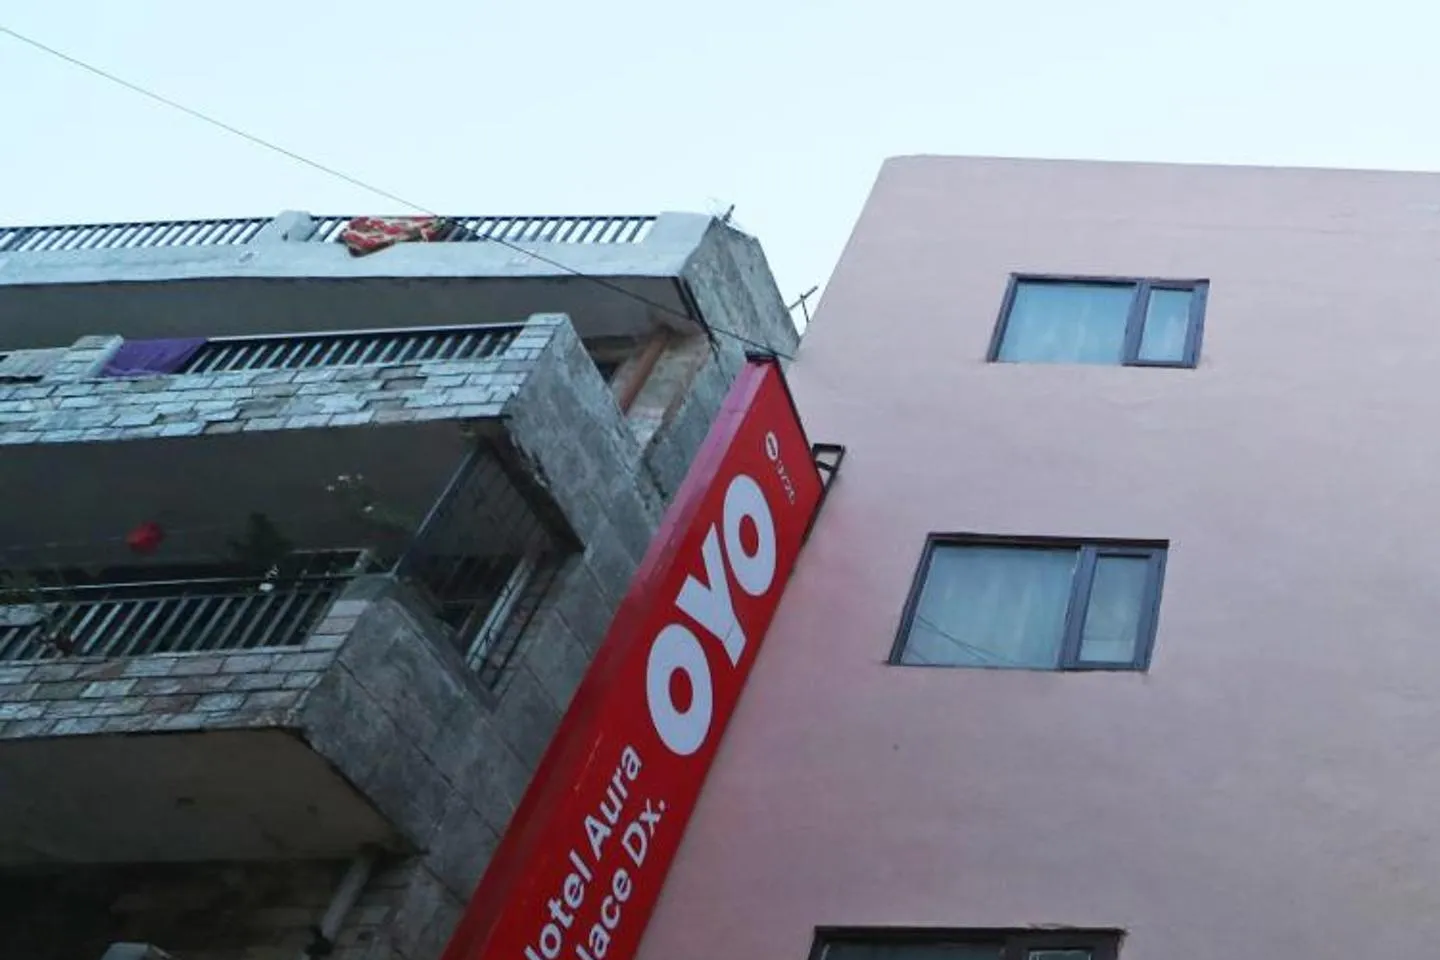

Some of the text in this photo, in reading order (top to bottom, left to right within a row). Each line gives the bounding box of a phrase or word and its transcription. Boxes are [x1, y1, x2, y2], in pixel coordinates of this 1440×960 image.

[646, 474, 778, 757] OYO
[581, 743, 643, 845] Aura
[621, 800, 667, 884] Dx.
